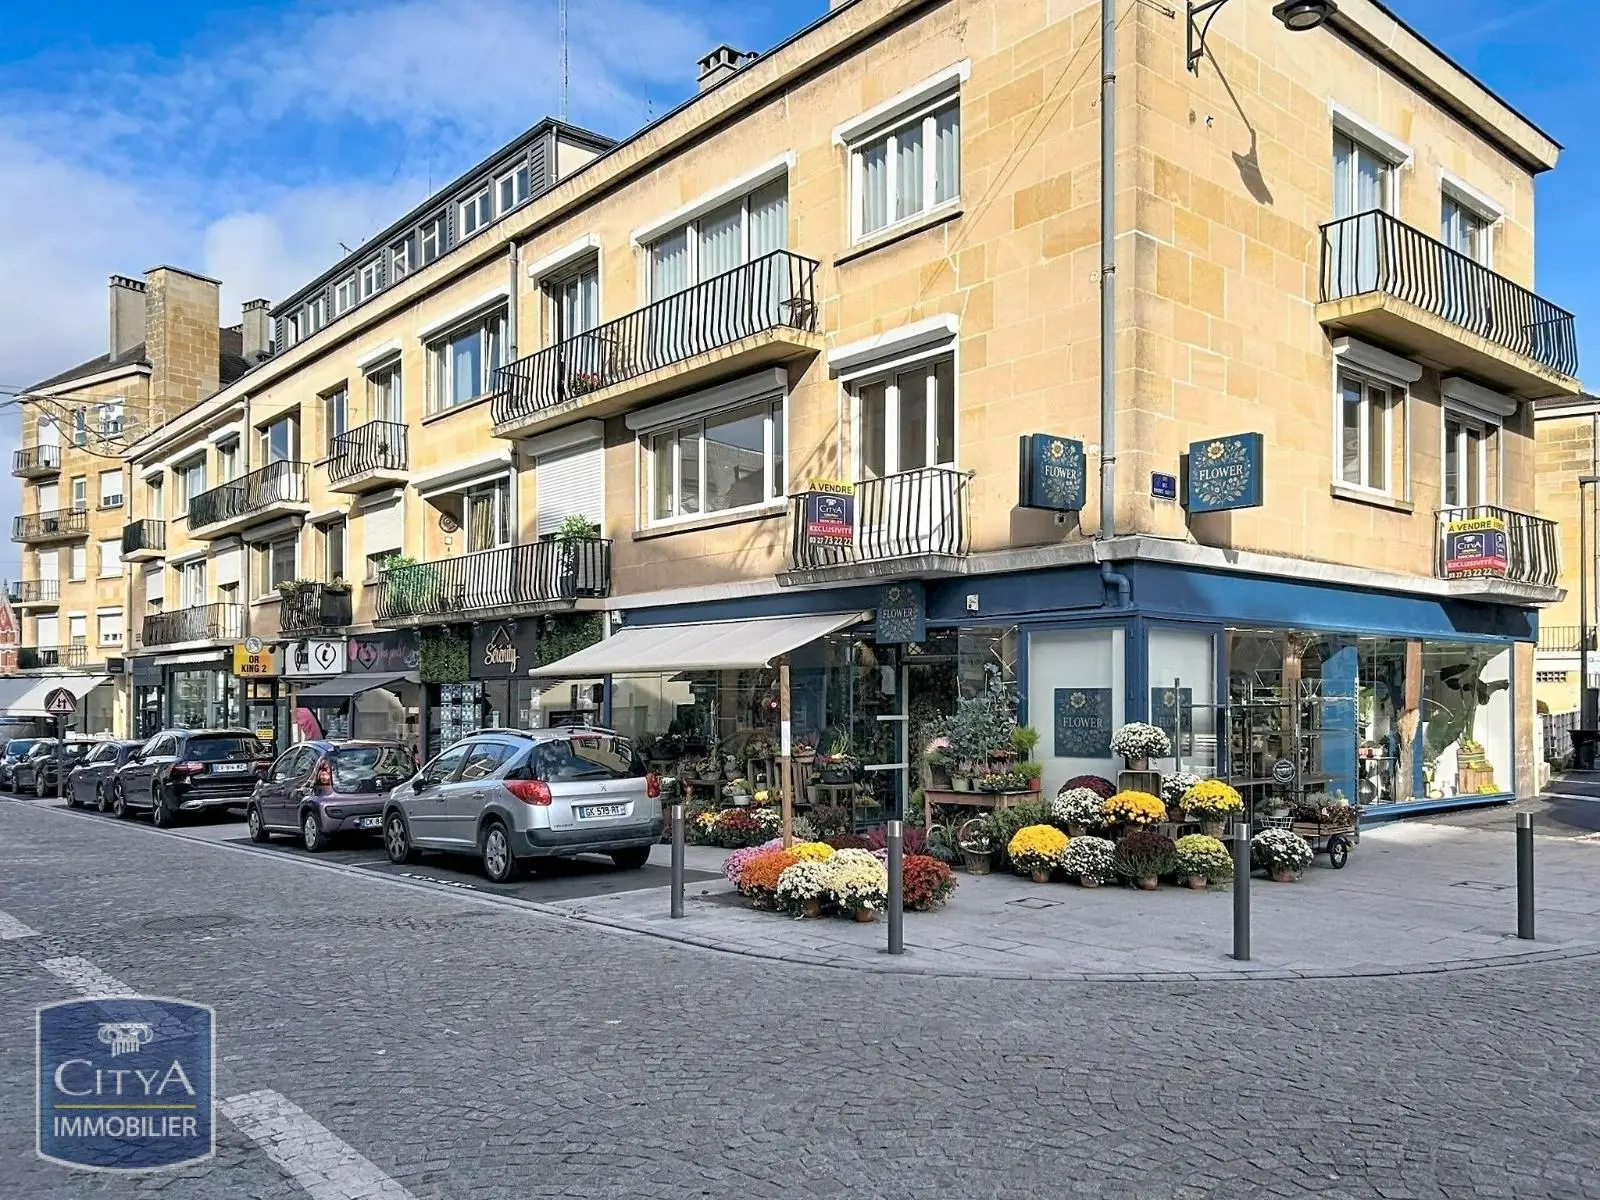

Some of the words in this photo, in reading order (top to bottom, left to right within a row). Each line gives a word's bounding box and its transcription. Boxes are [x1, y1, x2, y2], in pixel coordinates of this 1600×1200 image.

[1045, 464, 1077, 480] FLOWER
[1200, 464, 1243, 481] FLOWER
[818, 482, 852, 494] VENDRE
[1456, 520, 1492, 531] VENDRE
[824, 535, 833, 545] 73
[834, 536, 843, 546] 22
[844, 537, 852, 547] 22
[1463, 569, 1472, 577] 73
[1473, 568, 1482, 577] 22
[1483, 567, 1492, 576] 22
[882, 608, 913, 619] FLOWER
[248, 655, 260, 664] OR
[241, 664, 260, 673] KING
[261, 664, 267, 673] 2
[1063, 716, 1104, 728] FLOWER
